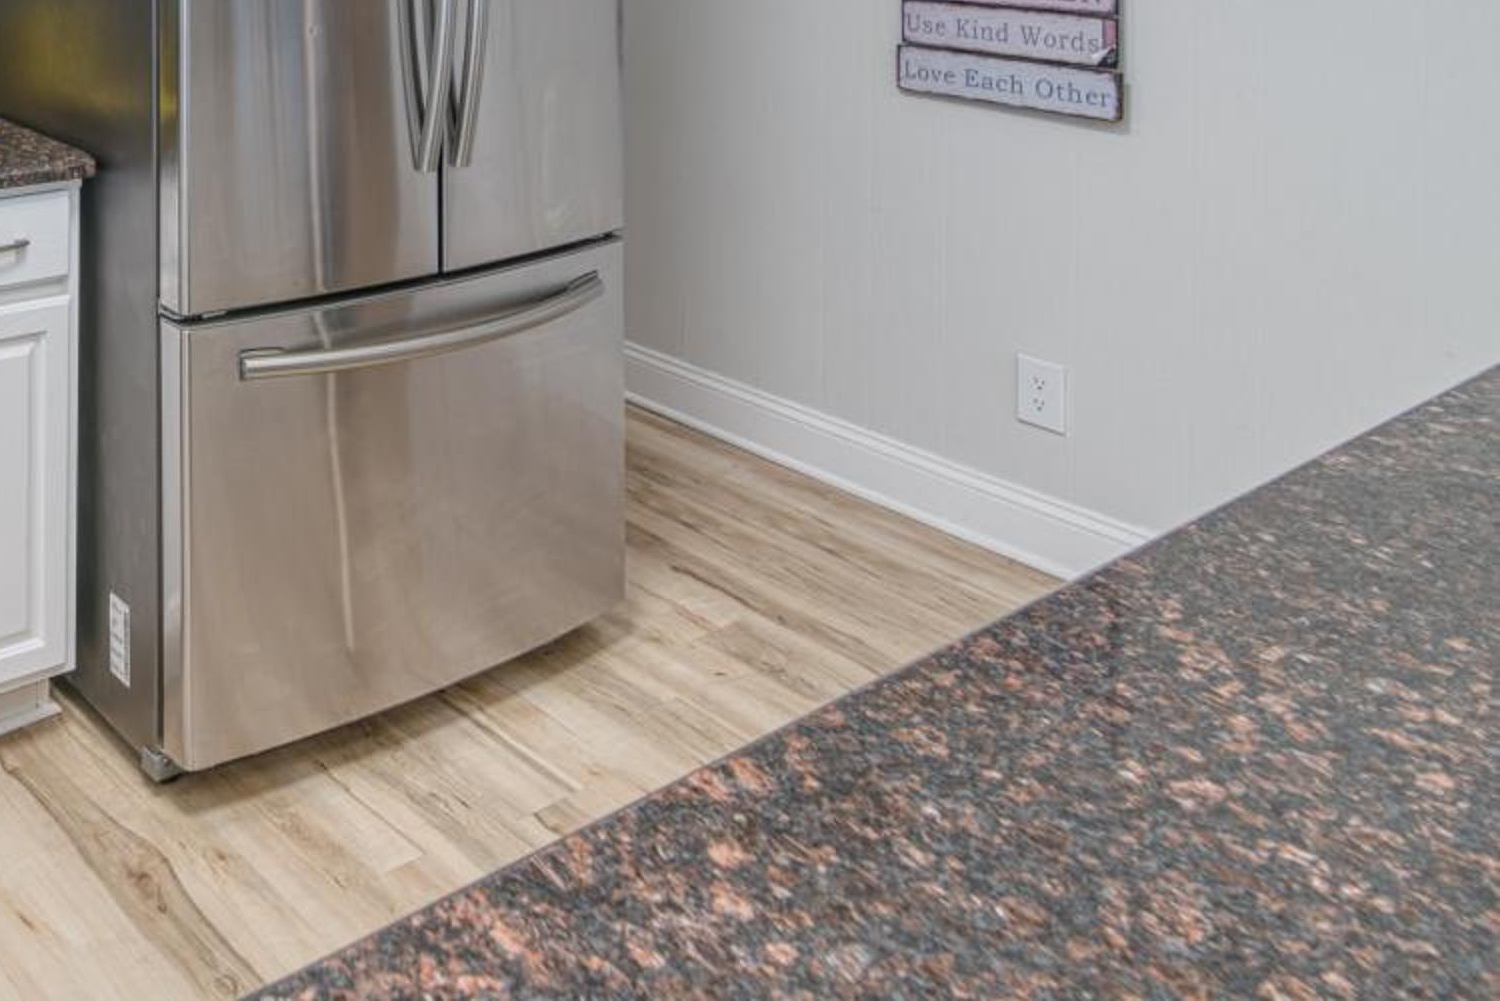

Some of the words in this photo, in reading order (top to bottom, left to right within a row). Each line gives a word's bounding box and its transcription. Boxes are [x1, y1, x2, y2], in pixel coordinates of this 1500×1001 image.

[905, 12, 946, 33] Use
[956, 18, 1009, 43] Kind
[1020, 24, 1100, 53] Words
[904, 60, 956, 85] Love
[964, 68, 1024, 95] Each
[1035, 78, 1108, 108] Other
